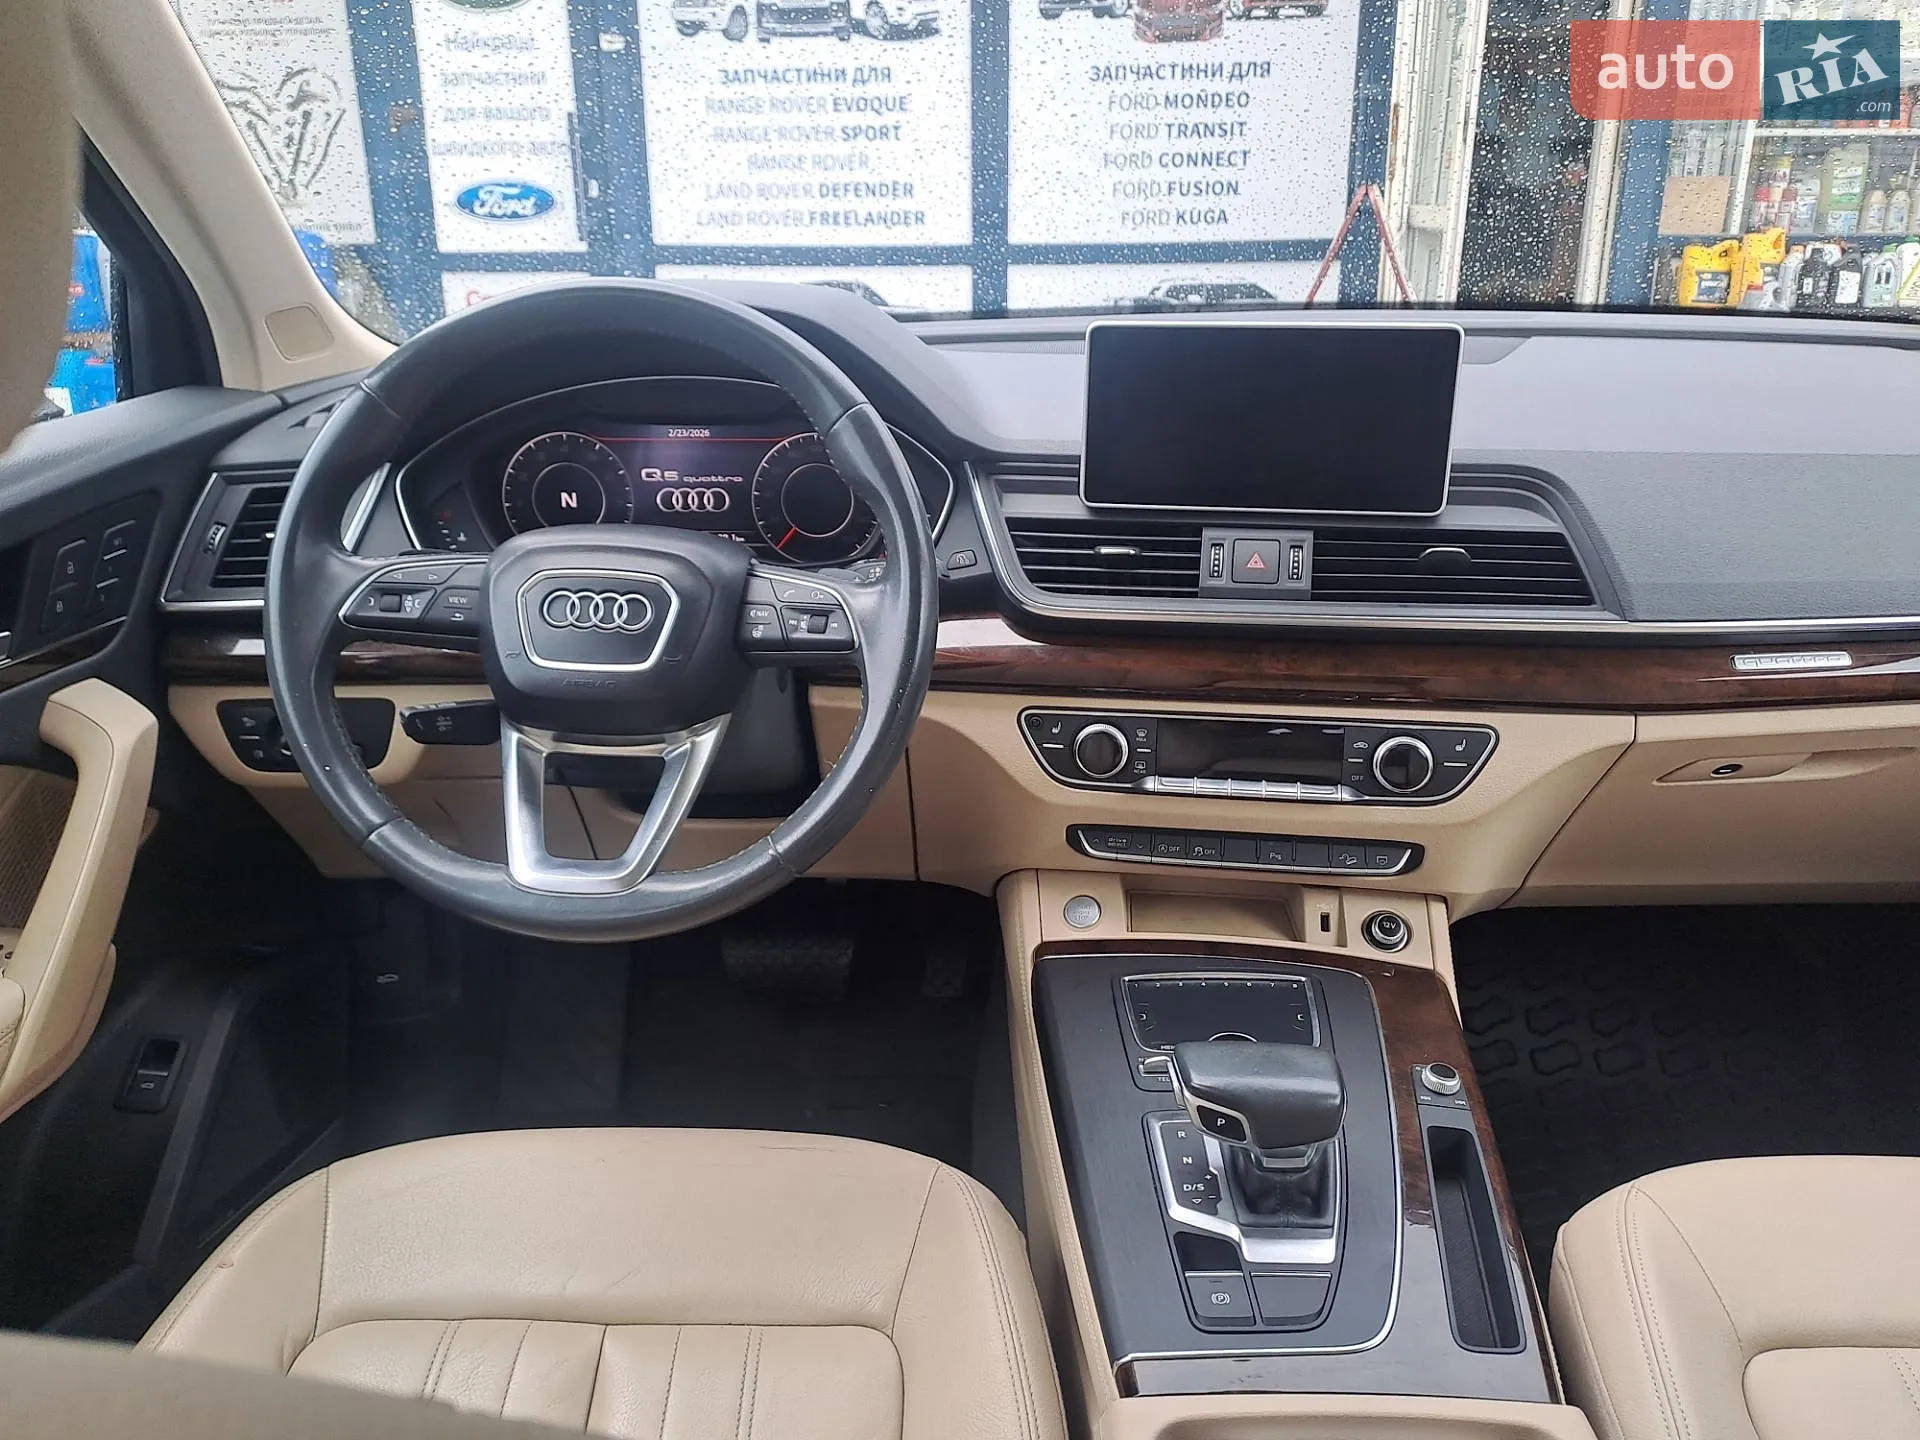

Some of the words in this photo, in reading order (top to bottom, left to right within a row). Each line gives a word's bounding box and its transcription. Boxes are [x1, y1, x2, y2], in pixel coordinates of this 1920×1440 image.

[718, 67, 848, 85] ЗАПЧАСТИНИ
[852, 66, 892, 87] ДЛЯ
[1089, 62, 1226, 83] ЗАПЧАСТИНИ
[1228, 61, 1272, 84] ДЛЯ
[705, 96, 766, 114] RANGE
[768, 96, 829, 114] ROVER
[832, 95, 909, 116] EVOQUE
[1108, 94, 1158, 111] FORD
[1163, 91, 1250, 110] MONDEO
[712, 125, 771, 142] RANGE
[776, 125, 836, 142] ROVER
[841, 124, 902, 142] SPORT
[1109, 123, 1159, 140] FORD
[1164, 122, 1248, 139] TRANSIT
[747, 153, 808, 171] RANGE
[812, 153, 870, 170] ROVER
[1102, 152, 1153, 169] FORD
[1158, 150, 1251, 168] CONNECT
[706, 182, 754, 200] LAND
[756, 182, 814, 199] ROVER
[818, 181, 915, 199] DEFENDER
[1112, 181, 1161, 198] FORD
[1167, 180, 1240, 196] FUSION
[473, 185, 537, 216] Ford
[697, 210, 744, 227] LAND
[746, 210, 804, 226] ROVER
[808, 210, 926, 226] FREELANDER
[1121, 210, 1171, 226] FORD
[1176, 208, 1229, 225] KUGA
[667, 428, 711, 438] 2/23/2026
[641, 467, 679, 482] Q5
[682, 475, 743, 483] quattro
[560, 491, 578, 508] N
[1216, 1118, 1225, 1127] P
[1177, 1130, 1187, 1139] R
[1183, 1156, 1193, 1165] N
[1183, 1183, 1205, 1192] D/S
